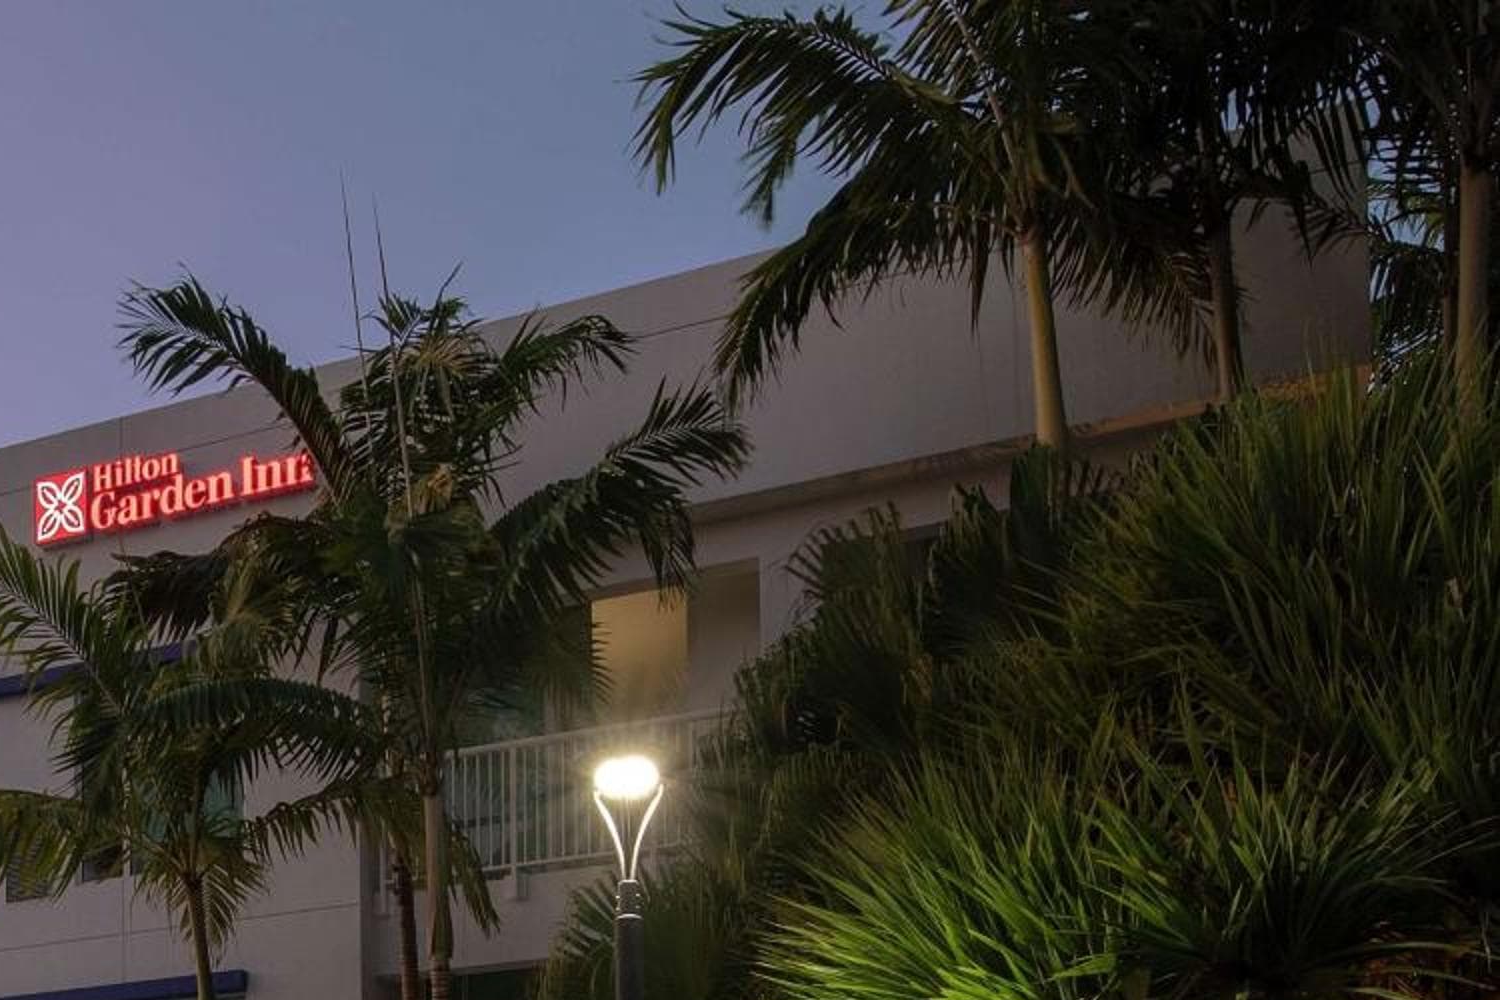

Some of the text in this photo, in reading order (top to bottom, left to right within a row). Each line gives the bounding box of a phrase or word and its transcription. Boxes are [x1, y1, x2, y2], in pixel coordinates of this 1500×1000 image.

[91, 453, 313, 529] Garden Inn
[93, 453, 178, 492] Hilton
